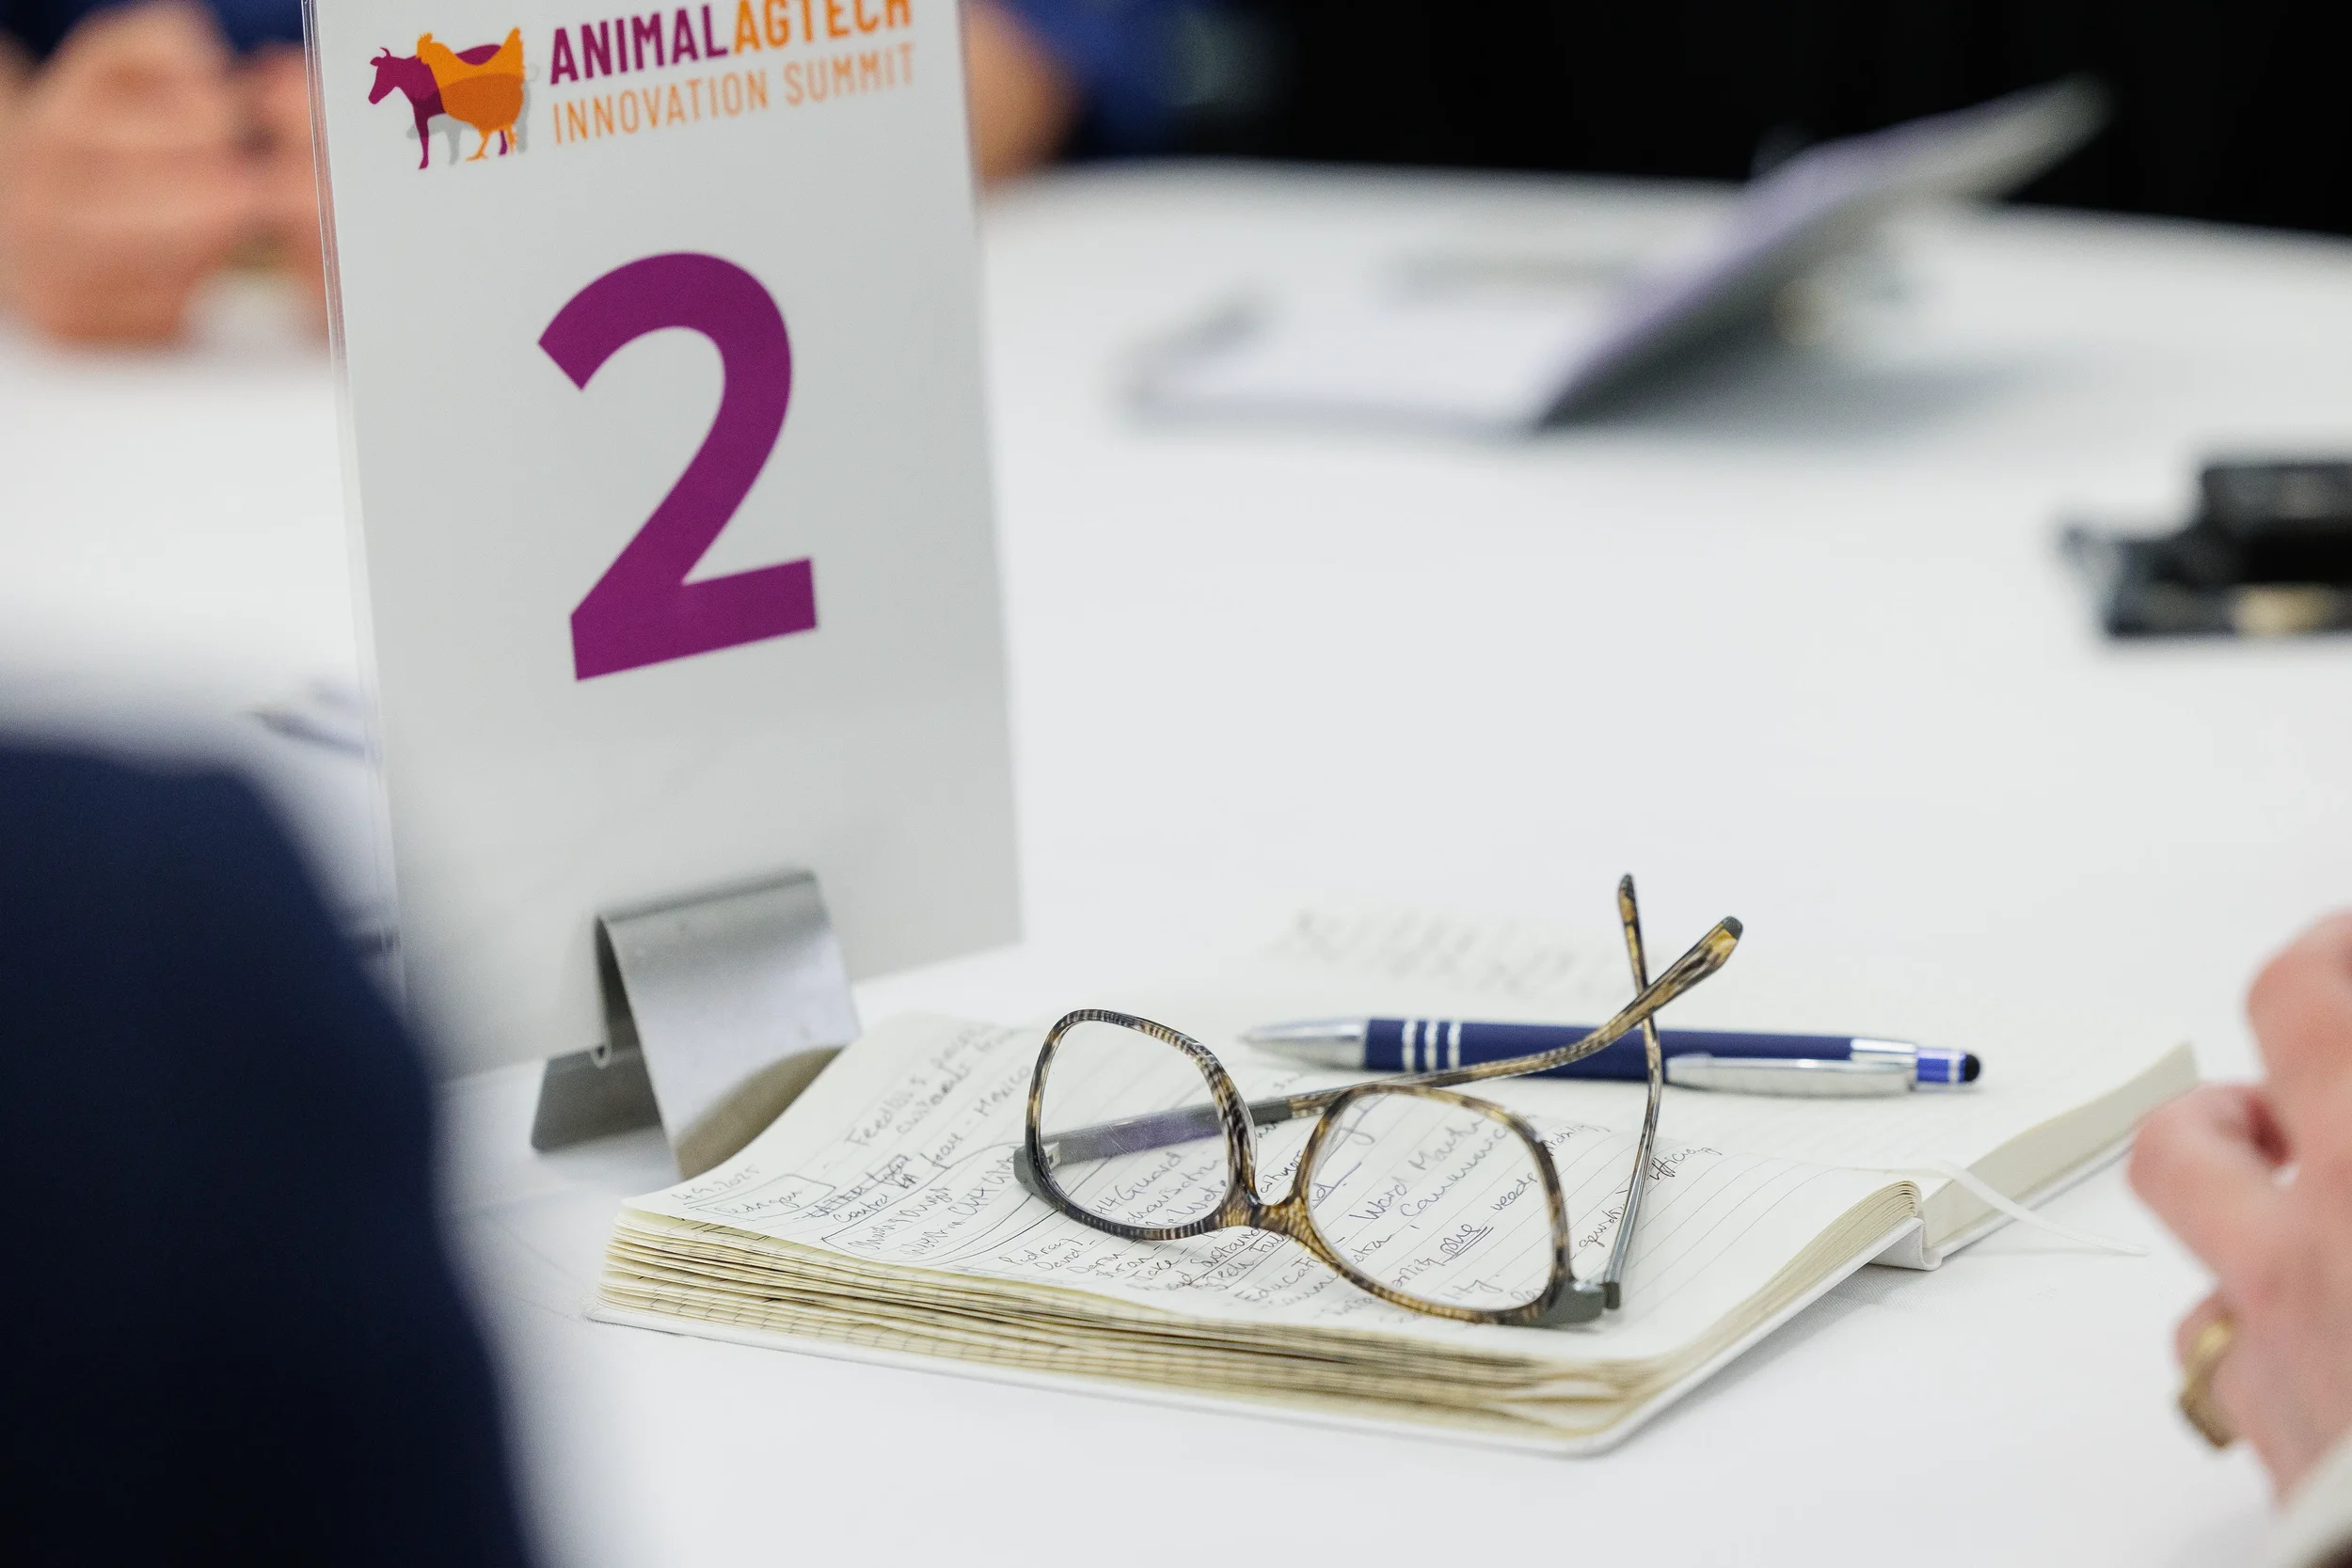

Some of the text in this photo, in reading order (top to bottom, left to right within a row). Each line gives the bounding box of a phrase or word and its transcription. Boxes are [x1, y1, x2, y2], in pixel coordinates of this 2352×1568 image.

[552, 41, 915, 147] INNOVATION SUMMIT
[537, 251, 817, 680] 2
